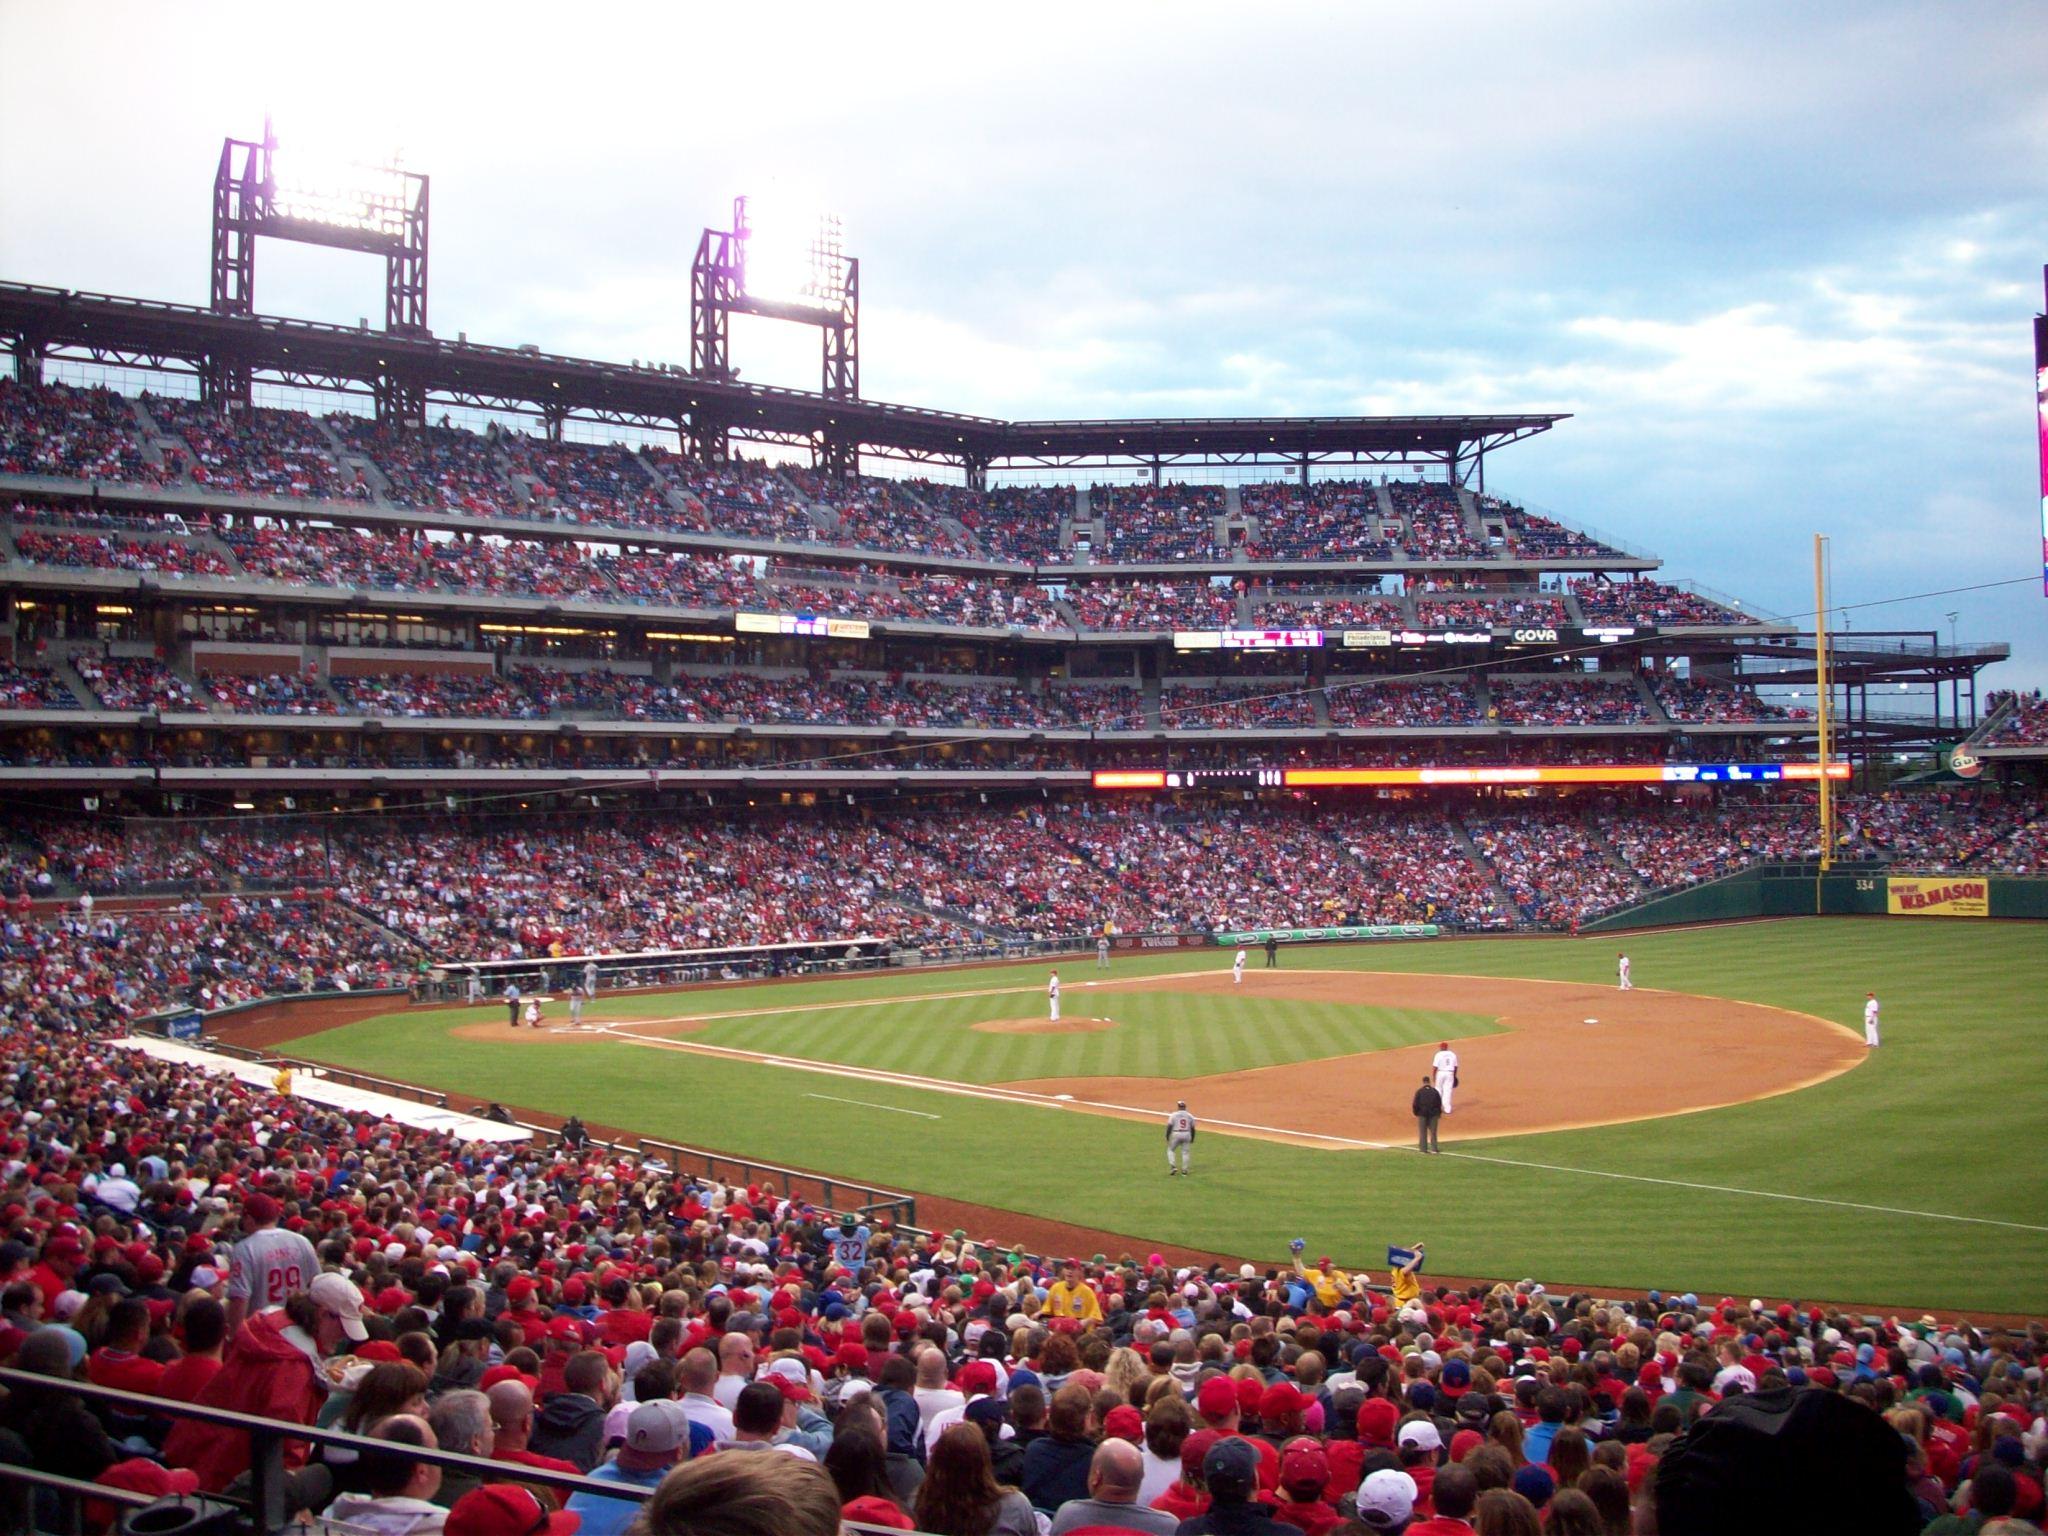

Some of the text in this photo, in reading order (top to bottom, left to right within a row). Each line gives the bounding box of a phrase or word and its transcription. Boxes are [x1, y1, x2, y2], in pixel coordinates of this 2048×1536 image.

[1514, 629, 1557, 642] GOYA
[1856, 879, 1874, 891] 334
[1180, 1119, 1187, 1129] 9
[841, 1241, 862, 1260] 32
[268, 1266, 300, 1302] 29
